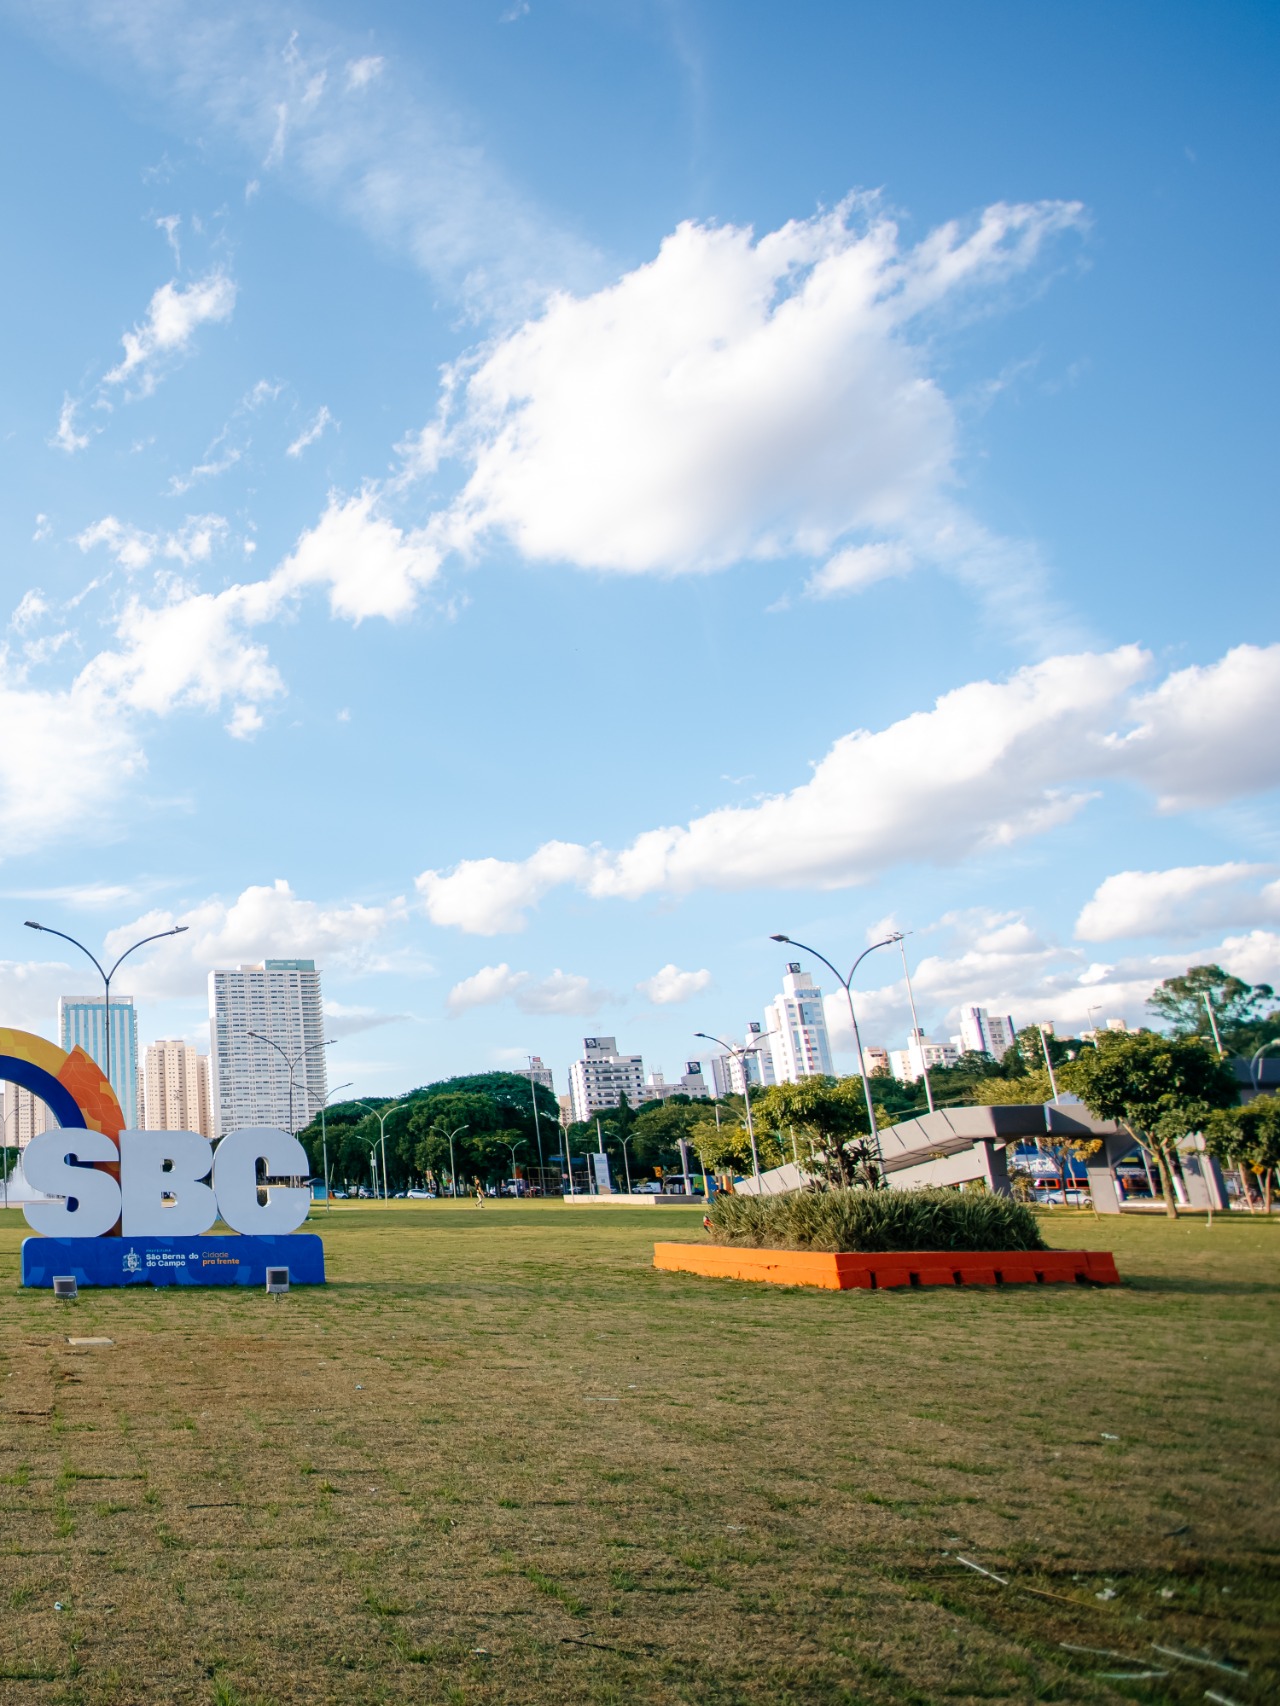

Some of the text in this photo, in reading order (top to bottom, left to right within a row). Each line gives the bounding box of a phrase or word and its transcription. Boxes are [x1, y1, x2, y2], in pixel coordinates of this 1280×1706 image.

[22, 1127, 310, 1238] SBC
[158, 1260, 186, 1268] Campo
[202, 1259, 215, 1267] pra
